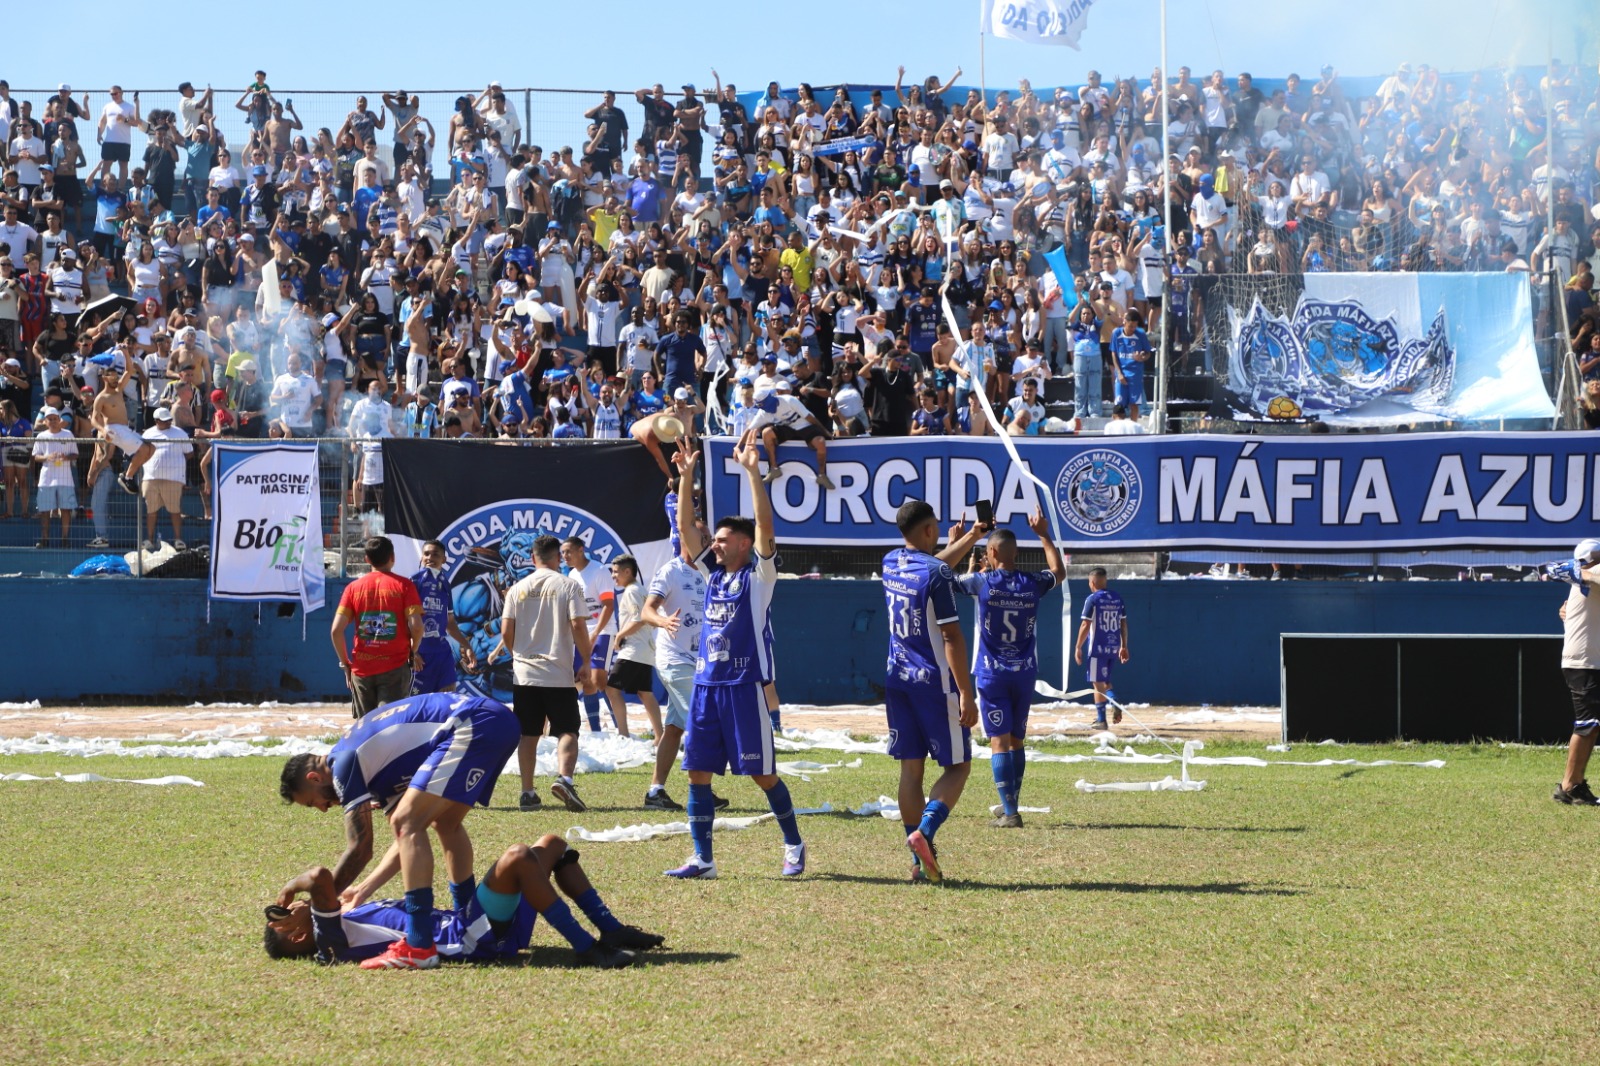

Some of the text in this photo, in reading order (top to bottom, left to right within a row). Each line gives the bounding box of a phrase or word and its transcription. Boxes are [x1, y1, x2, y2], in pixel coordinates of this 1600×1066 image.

[724, 441, 1600, 525] TORCIDA MÁFIA AZU
[1060, 451, 1138, 489] TORCIDA MÁFIA AZUL
[260, 484, 311, 495] MASTE
[1060, 498, 1138, 532] QUEBRADA QUERIDA
[1000, 599, 1024, 607] BANCA
[1001, 610, 1019, 643] 5
[1103, 610, 1119, 633] 98
[734, 656, 751, 668] HP
